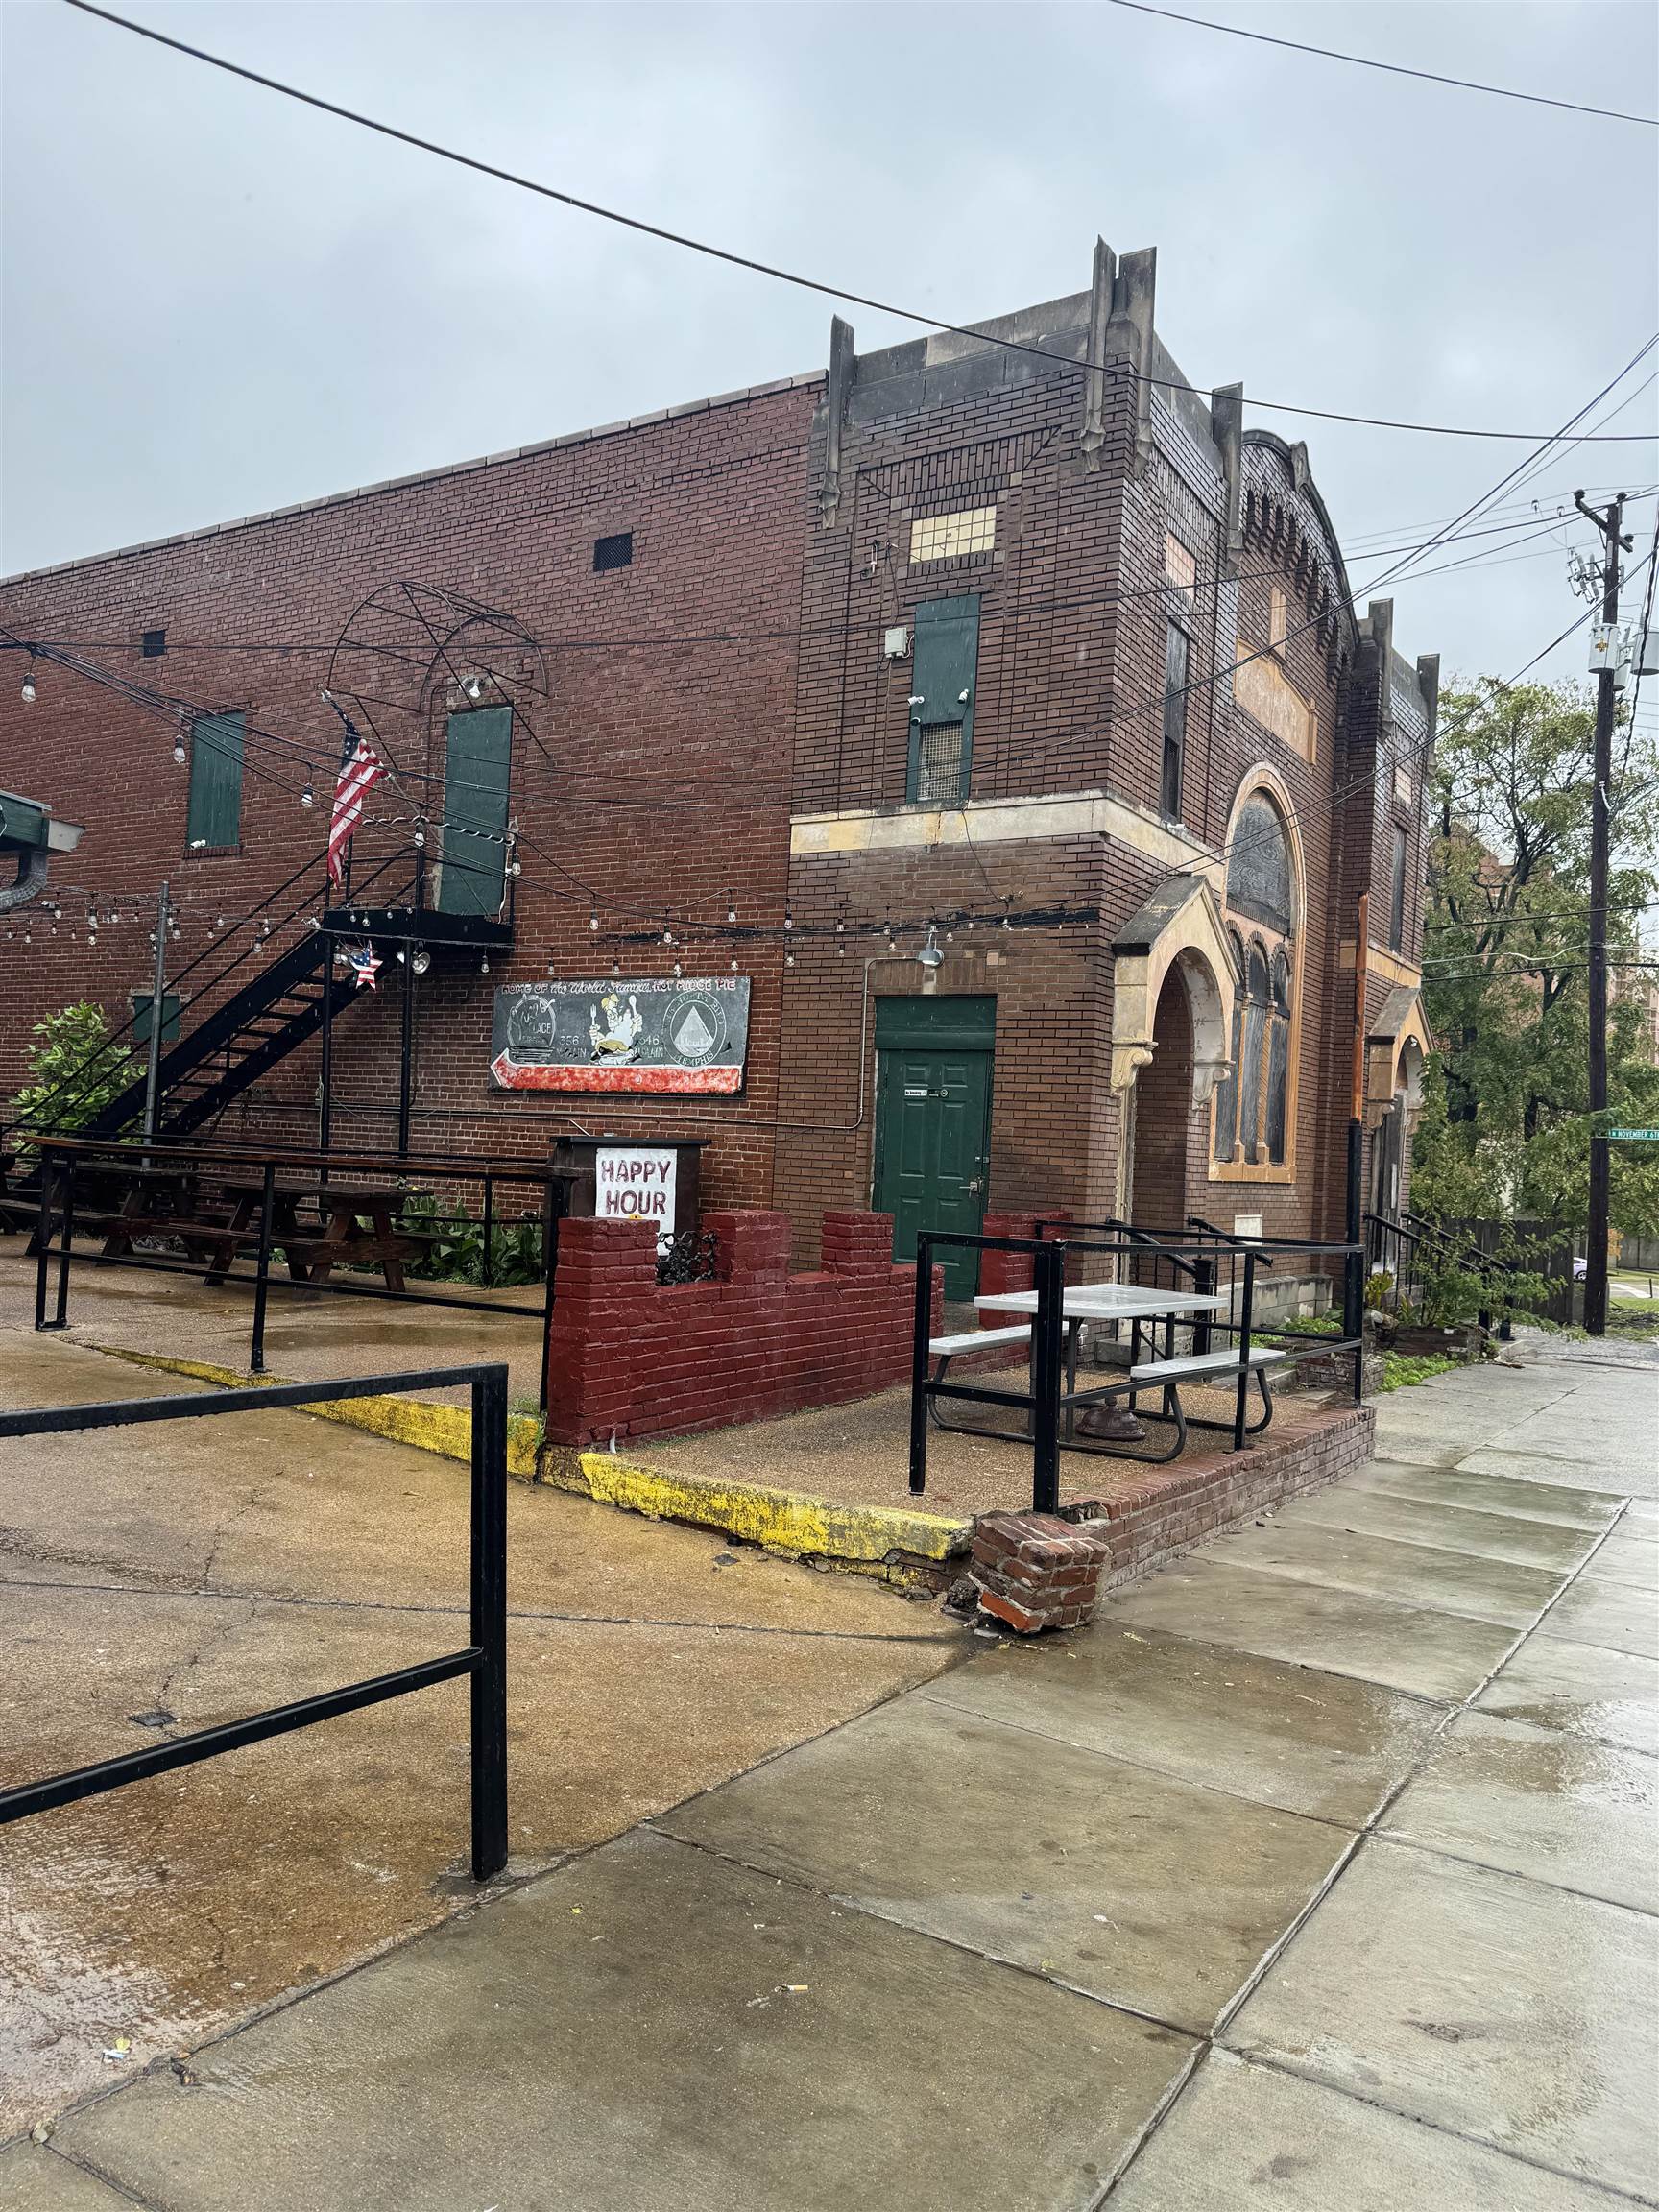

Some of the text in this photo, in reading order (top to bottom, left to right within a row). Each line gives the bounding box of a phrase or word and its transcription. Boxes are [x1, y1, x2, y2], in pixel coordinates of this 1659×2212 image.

[501, 983, 533, 995] HOME
[534, 983, 549, 994] OF
[568, 980, 606, 994] World
[653, 979, 674, 992] HOT
[715, 978, 736, 992] PIE
[601, 1159, 672, 1183] HAPPY
[605, 1190, 666, 1214] HOUR
